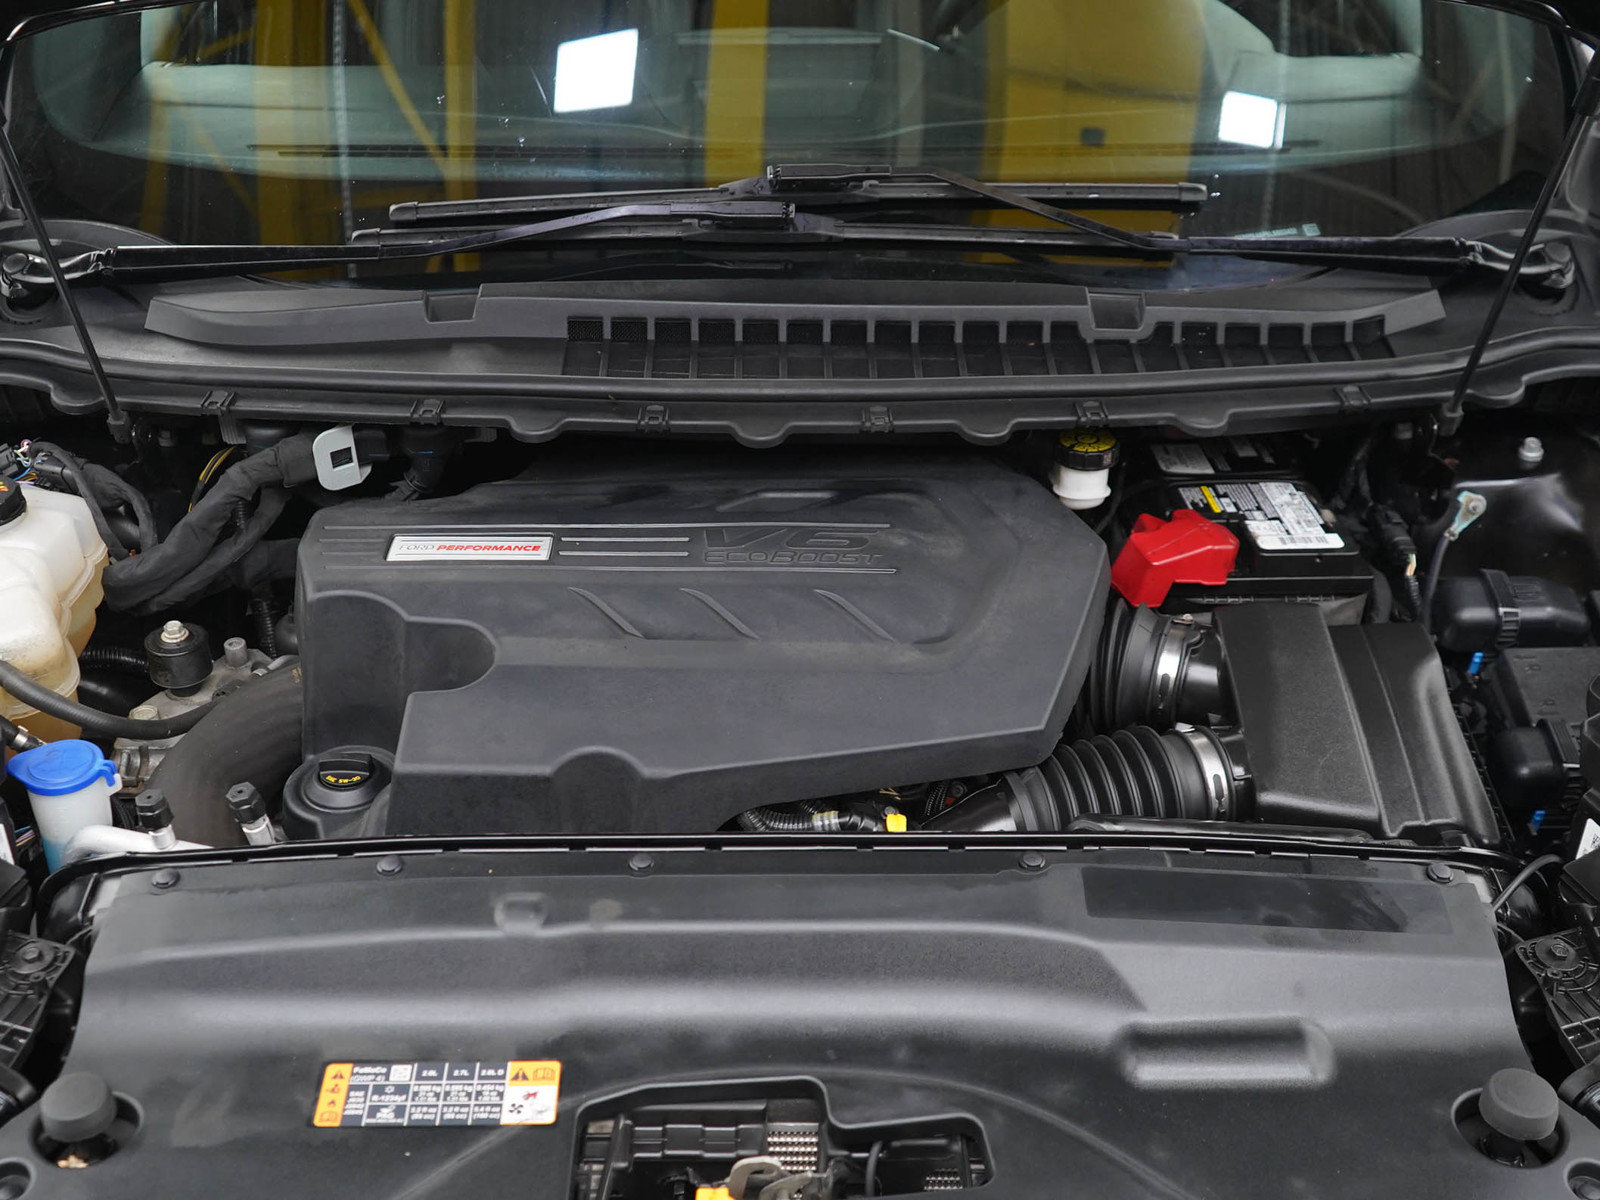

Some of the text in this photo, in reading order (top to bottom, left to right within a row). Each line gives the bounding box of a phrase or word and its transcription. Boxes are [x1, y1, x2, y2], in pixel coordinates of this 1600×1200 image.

[704, 527, 881, 549] V6
[399, 543, 542, 552] FORD PERFORMANCE
